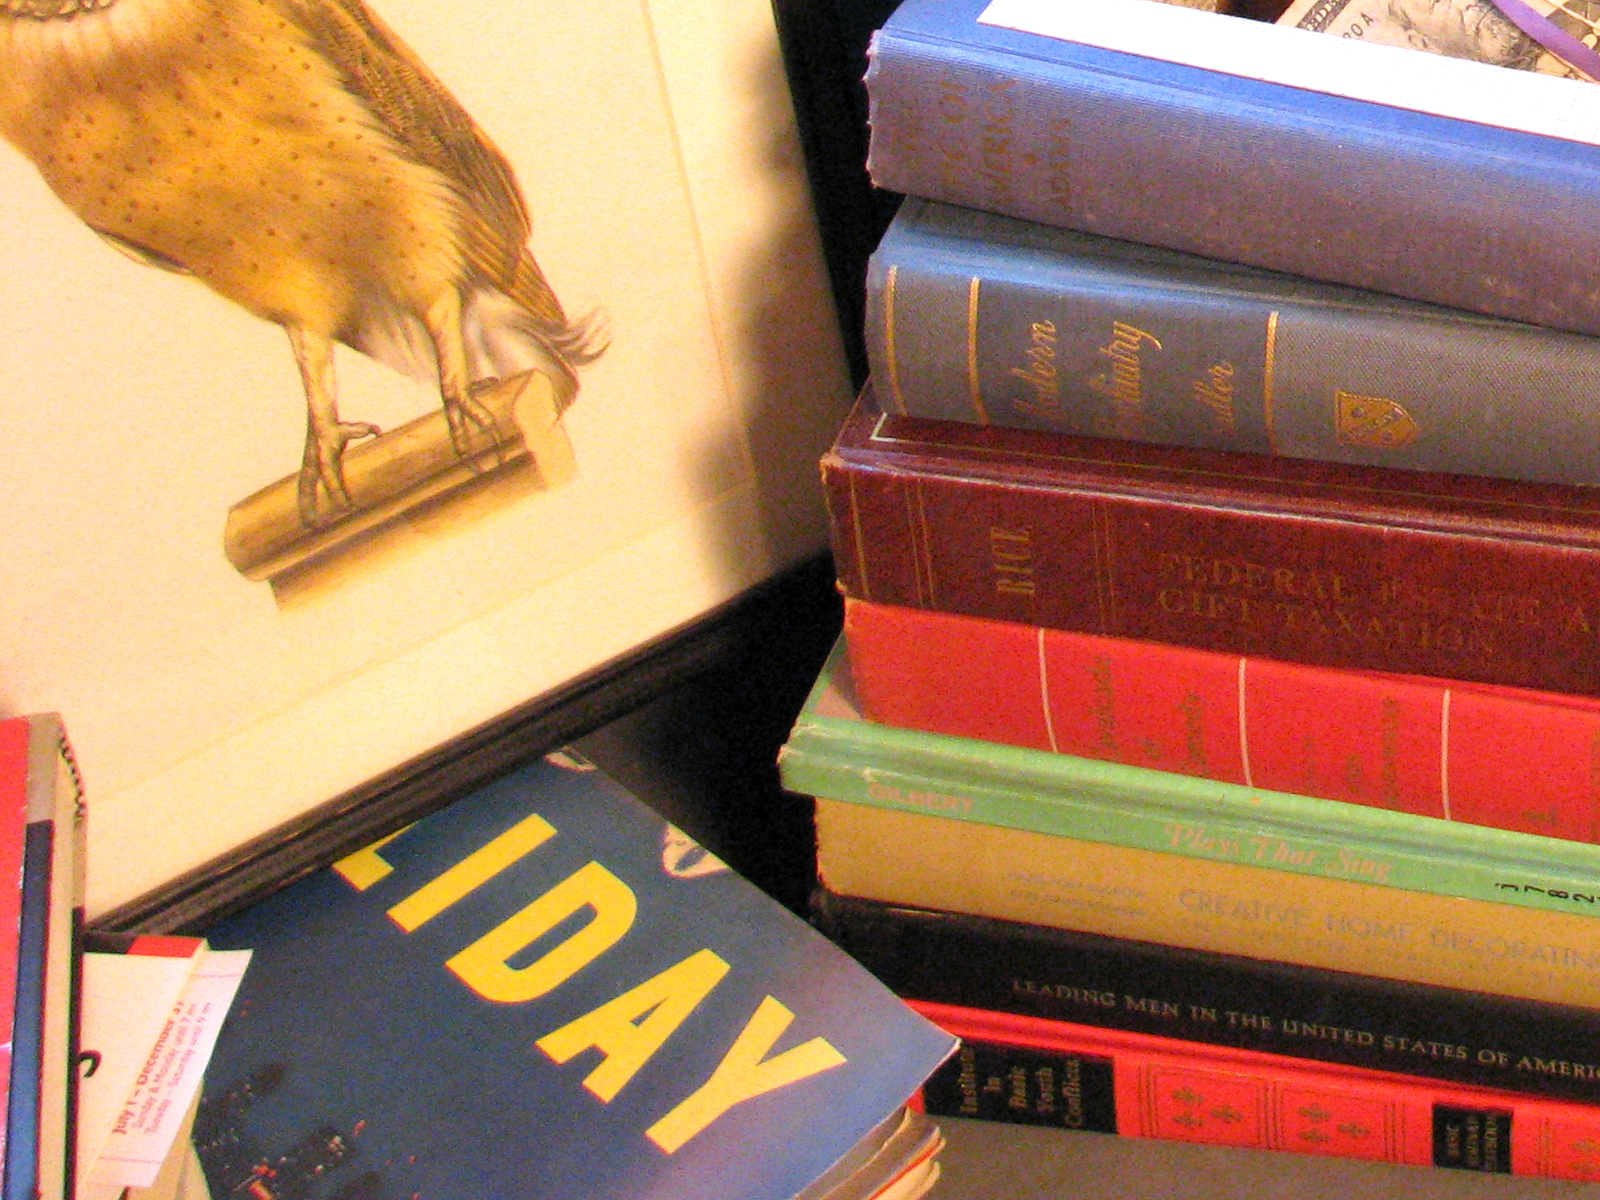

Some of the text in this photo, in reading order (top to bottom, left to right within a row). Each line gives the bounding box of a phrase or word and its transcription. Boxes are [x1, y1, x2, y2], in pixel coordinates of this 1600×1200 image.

[1164, 821, 1396, 886] Plays That Sing
[1178, 887, 1312, 930] CREATIVE
[1326, 914, 1413, 946] HOME
[1011, 977, 1116, 1009] LEADING
[1125, 993, 1179, 1021] MEN
[1190, 1003, 1218, 1024] IN
[1226, 1009, 1273, 1032] THE
[1280, 1017, 1373, 1048] UNITED
[1383, 1031, 1469, 1062] STATES
[1477, 1048, 1509, 1069] OF
[110, 1111, 136, 1133] July
